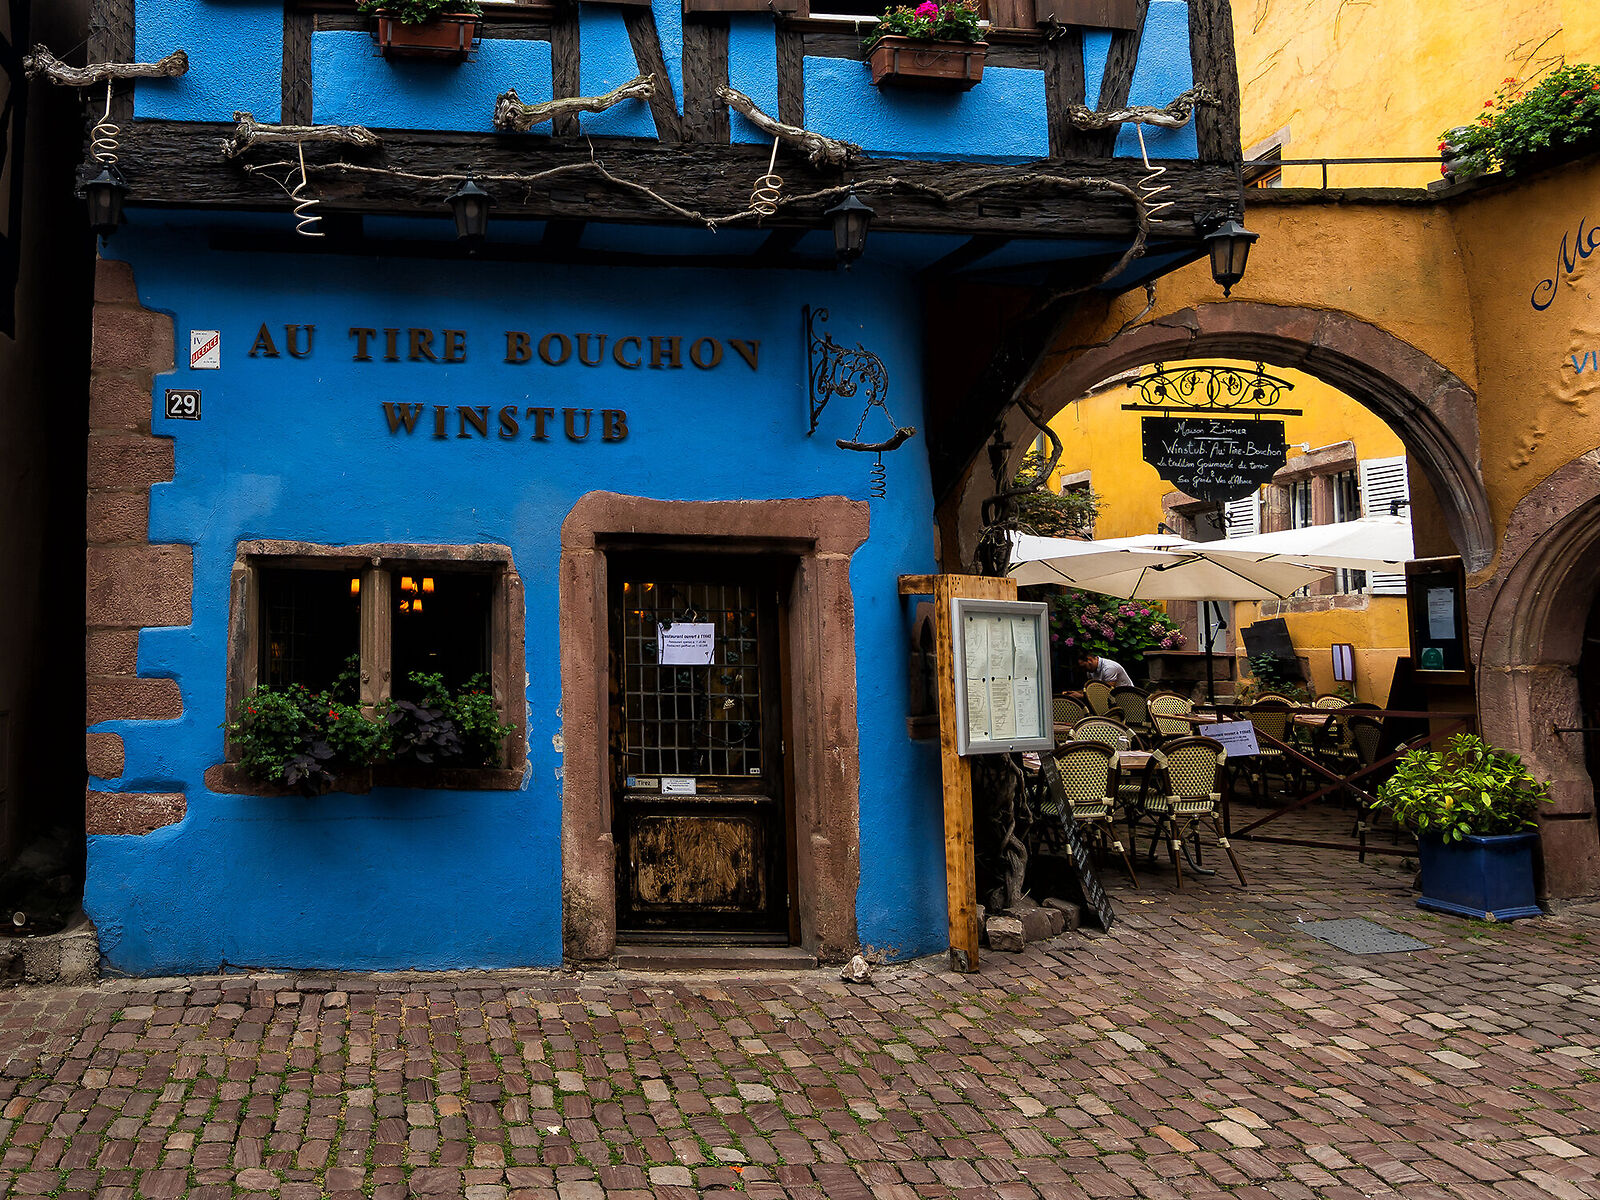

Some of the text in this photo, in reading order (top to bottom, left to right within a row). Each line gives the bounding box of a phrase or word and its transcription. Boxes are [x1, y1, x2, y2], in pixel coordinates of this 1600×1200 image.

[191, 335, 218, 362] LICENCE
[193, 337, 203, 345] IV
[248, 322, 761, 371] AU TIRE BOUCHON
[1571, 350, 1600, 374] VI
[170, 394, 196, 415] 29
[382, 401, 629, 441] WINSTUB
[1174, 421, 1205, 436] Maison
